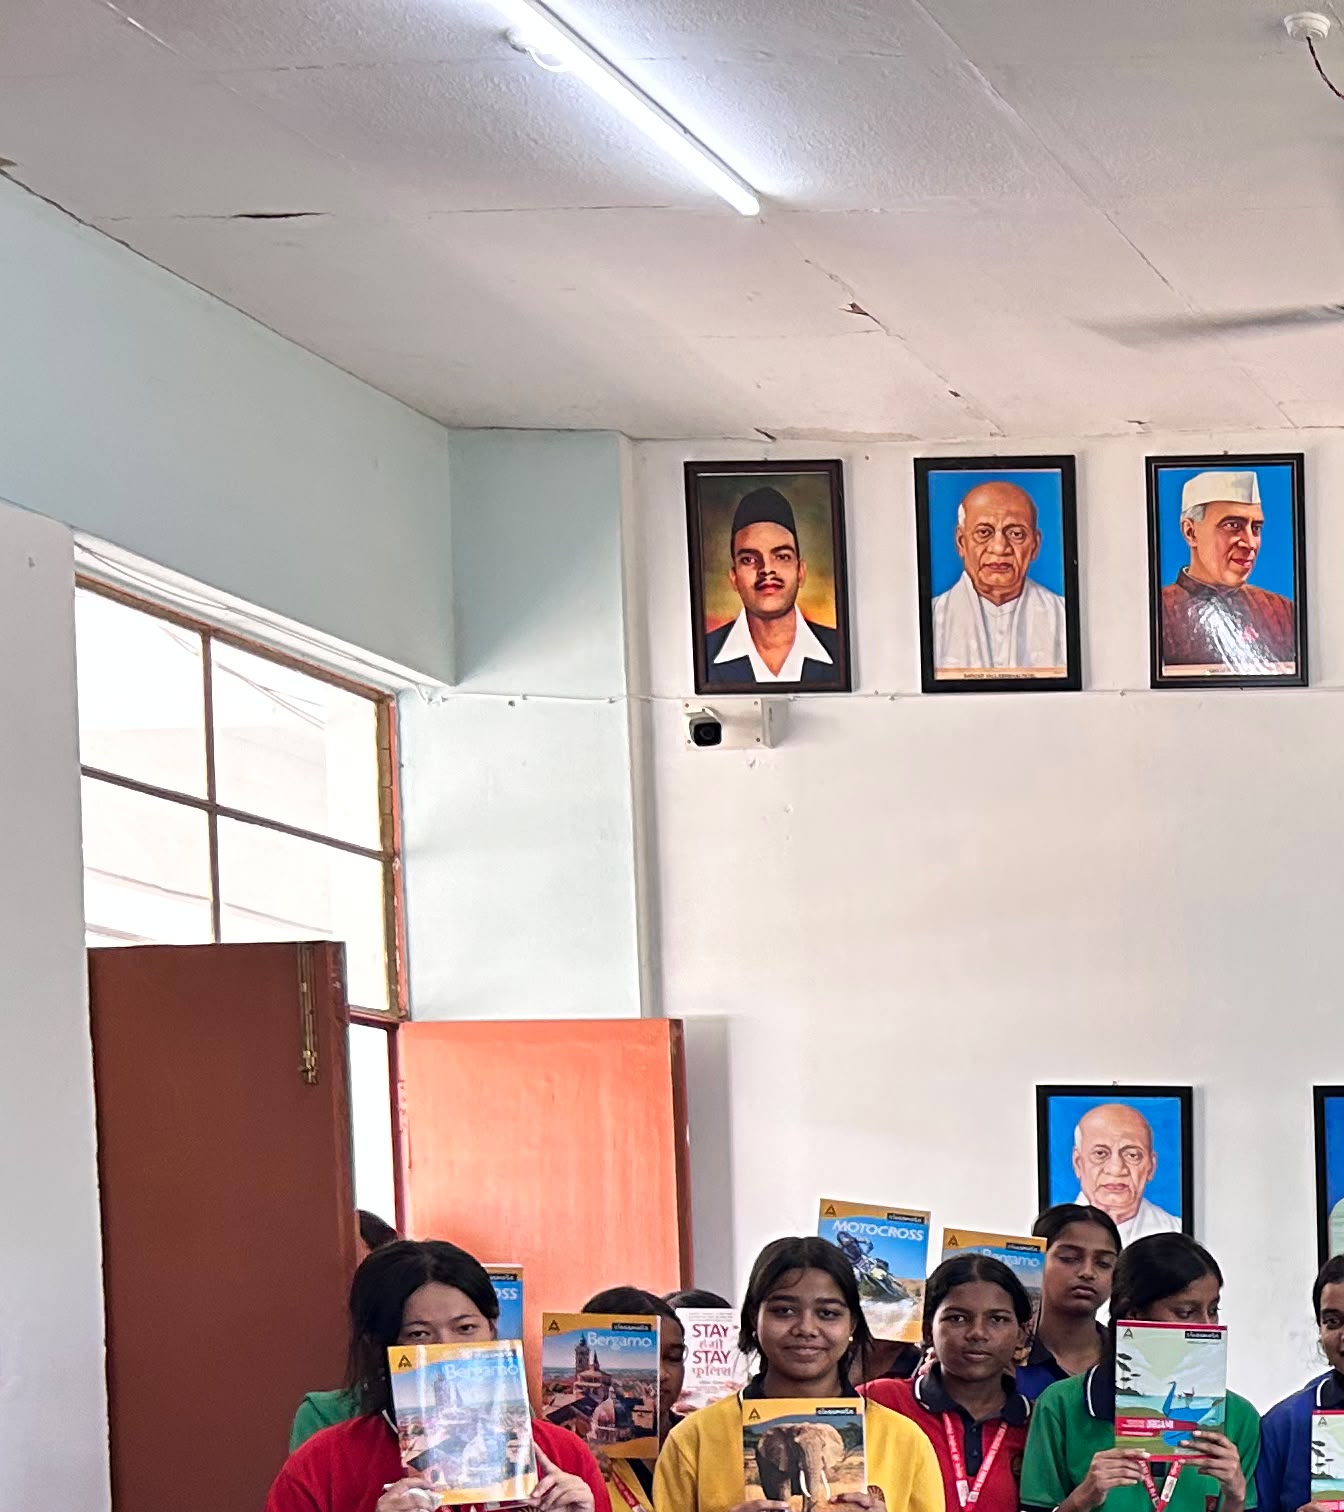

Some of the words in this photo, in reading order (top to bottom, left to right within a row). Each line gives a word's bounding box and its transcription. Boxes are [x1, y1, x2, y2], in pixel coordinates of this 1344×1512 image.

[832, 1220, 925, 1241] MOTOCROSS
[692, 1323, 729, 1338] STAY
[587, 1331, 653, 1350] Bergamo
[692, 1350, 732, 1364] STAY
